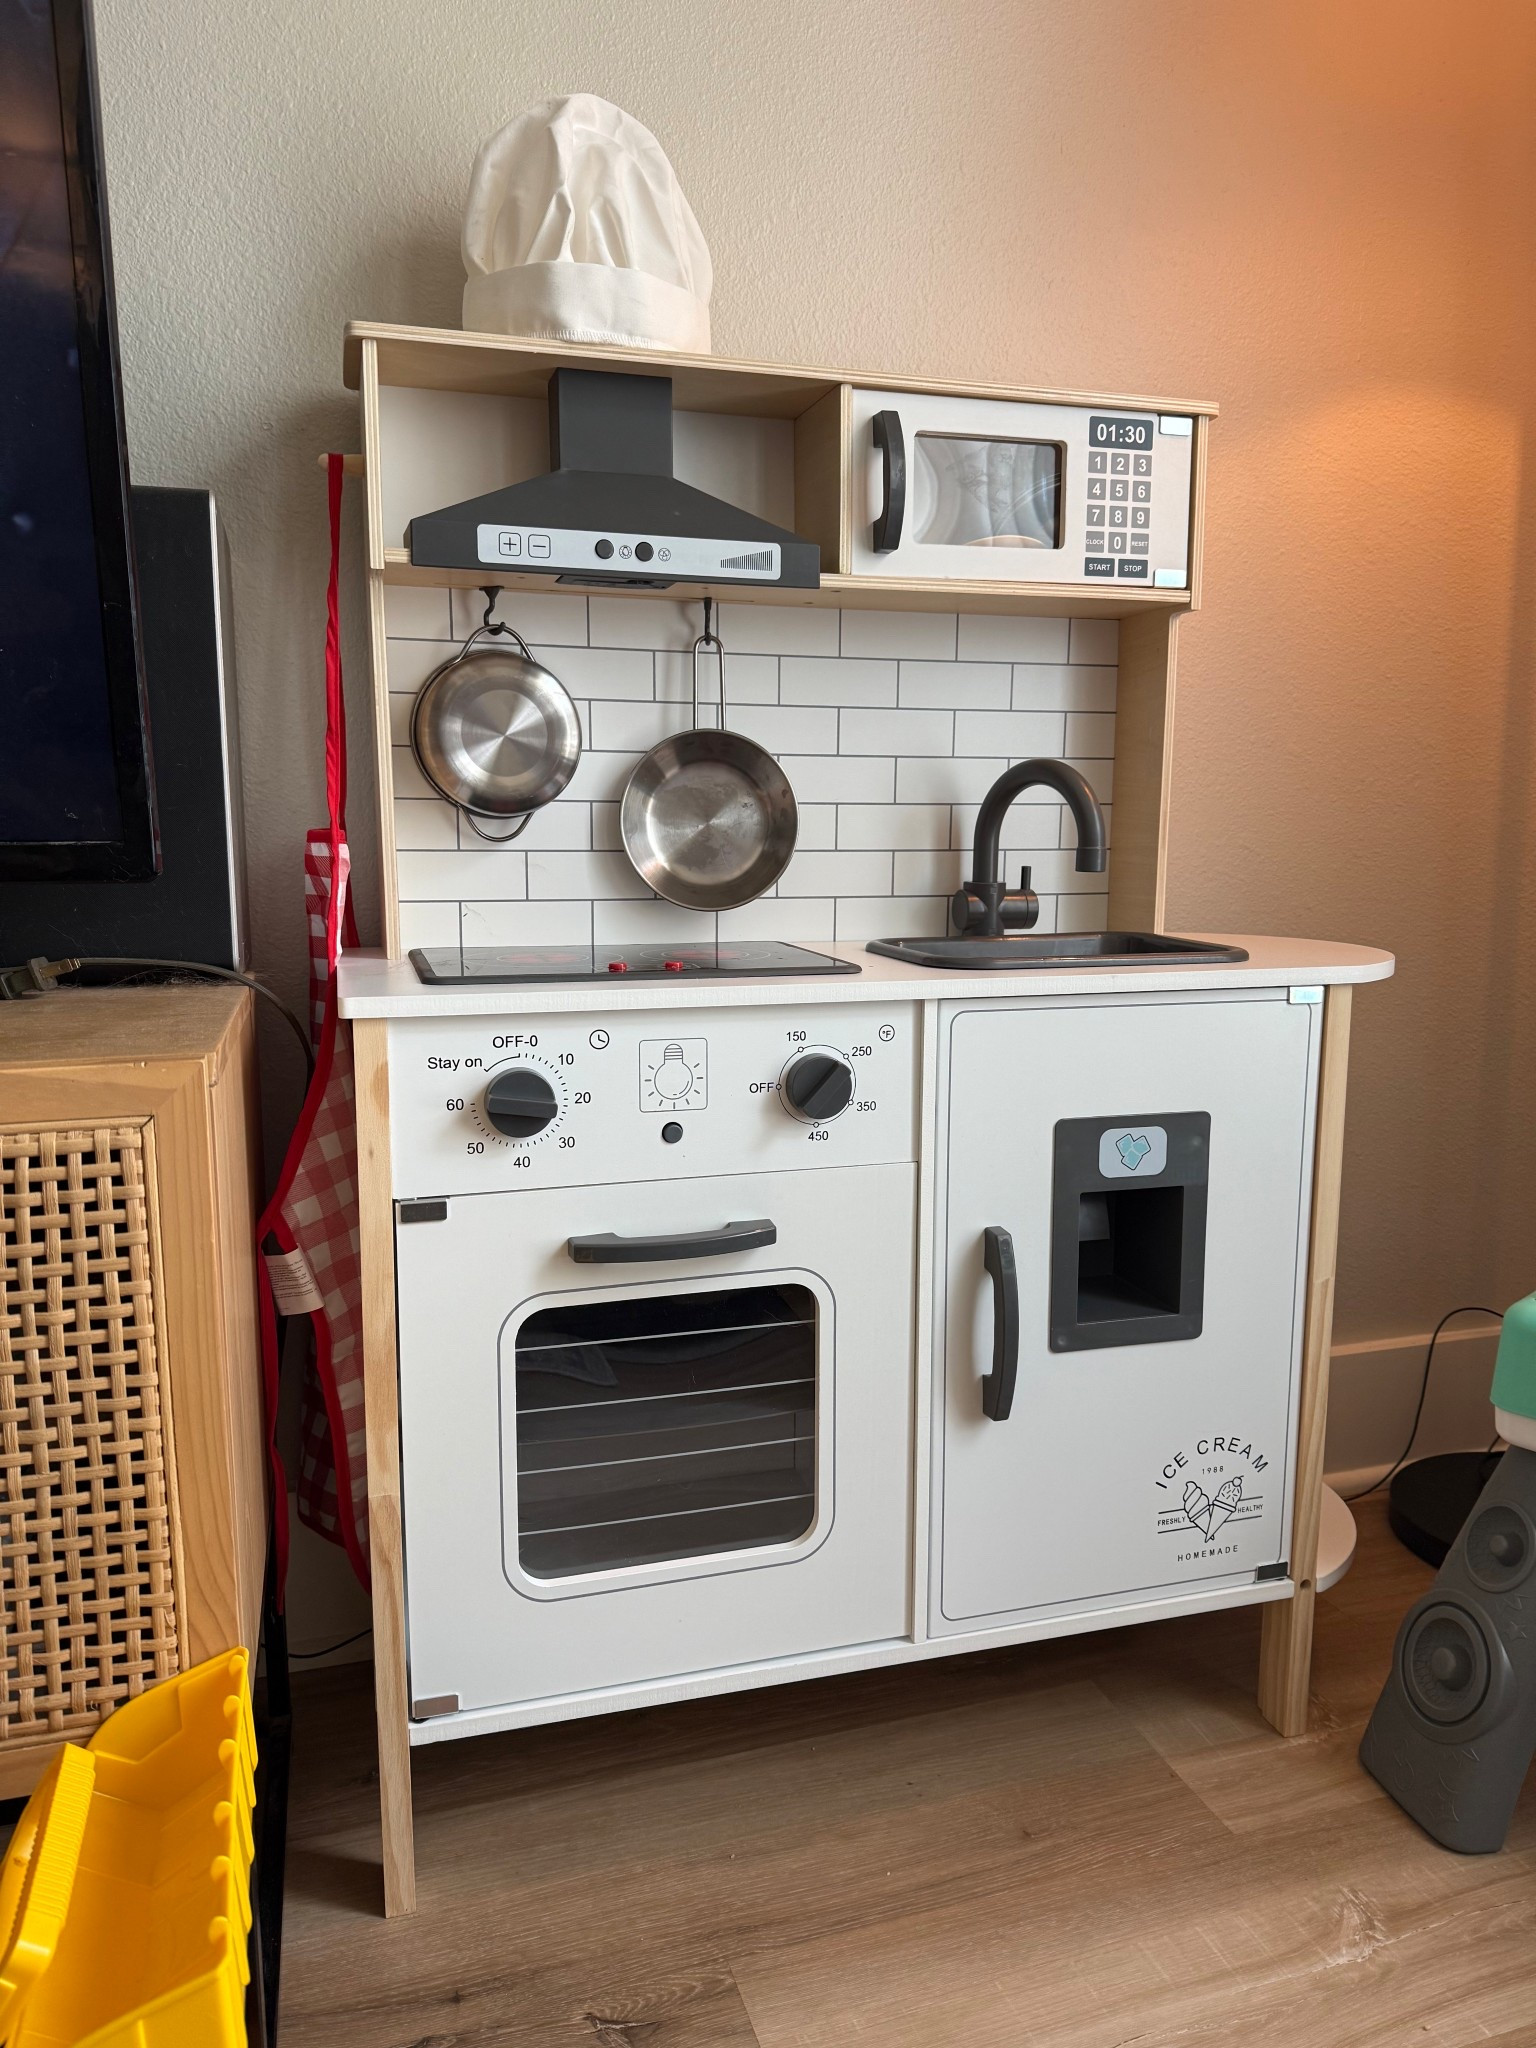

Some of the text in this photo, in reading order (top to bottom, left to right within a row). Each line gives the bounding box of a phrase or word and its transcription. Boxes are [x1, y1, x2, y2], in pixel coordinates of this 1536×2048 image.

[1097, 423, 1146, 444] 01:30
[1094, 456, 1147, 472] 1 2 3
[1092, 483, 1146, 498] 4 5 6
[1092, 509, 1145, 524] 7 8 9
[1113, 536, 1122, 549] 0
[1088, 563, 1142, 572] START STOP
[492, 1034, 538, 1048] OFF-0
[786, 1030, 807, 1042] 150
[851, 1045, 872, 1057] 250
[427, 1057, 483, 1071] Stay on
[558, 1053, 574, 1065] 10
[749, 1082, 774, 1093] OFF
[574, 1092, 591, 1104] 20
[446, 1098, 464, 1111] 60
[856, 1100, 877, 1112] 350
[808, 1130, 829, 1141] 450
[467, 1142, 485, 1154] 50
[558, 1136, 575, 1149] 30
[513, 1156, 531, 1168] 40
[1155, 1437, 1269, 1489] ICE CREAM
[1202, 1465, 1224, 1475] 1988
[1237, 1504, 1263, 1514] HEALTHY
[1157, 1516, 1186, 1526] FRESHLY
[1177, 1544, 1239, 1562] HOMEMADE
